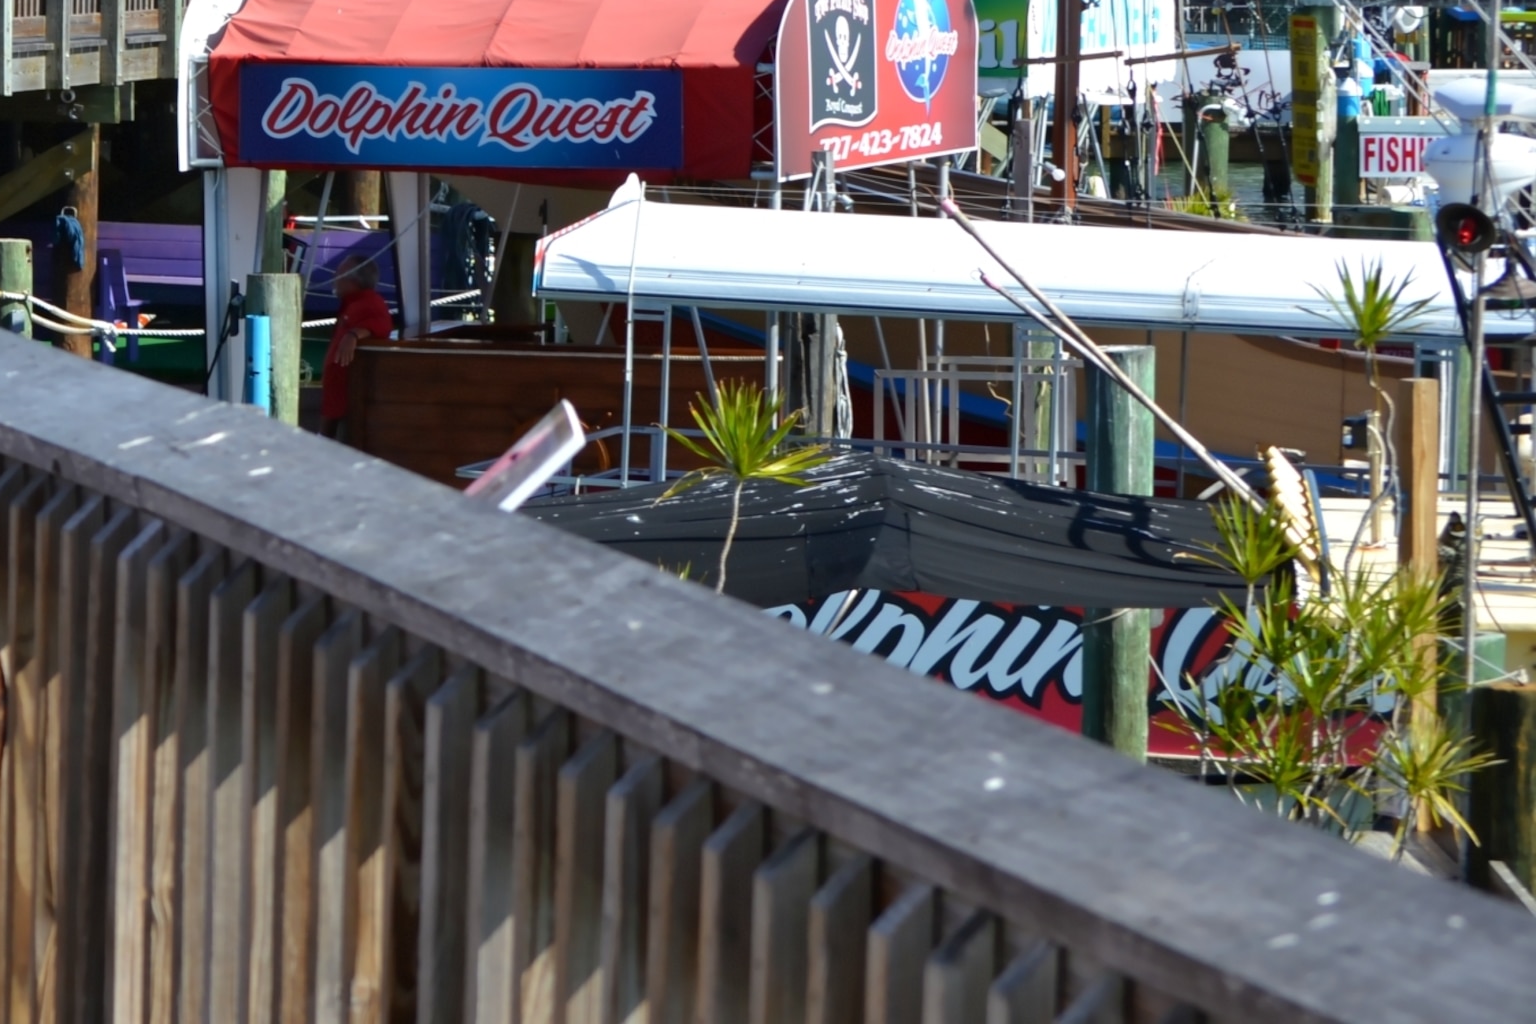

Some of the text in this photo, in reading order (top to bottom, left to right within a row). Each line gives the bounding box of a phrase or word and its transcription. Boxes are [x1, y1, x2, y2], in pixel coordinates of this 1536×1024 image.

[262, 77, 657, 155] Dolphin Quest
[819, 121, 942, 162] 727-423-7824
